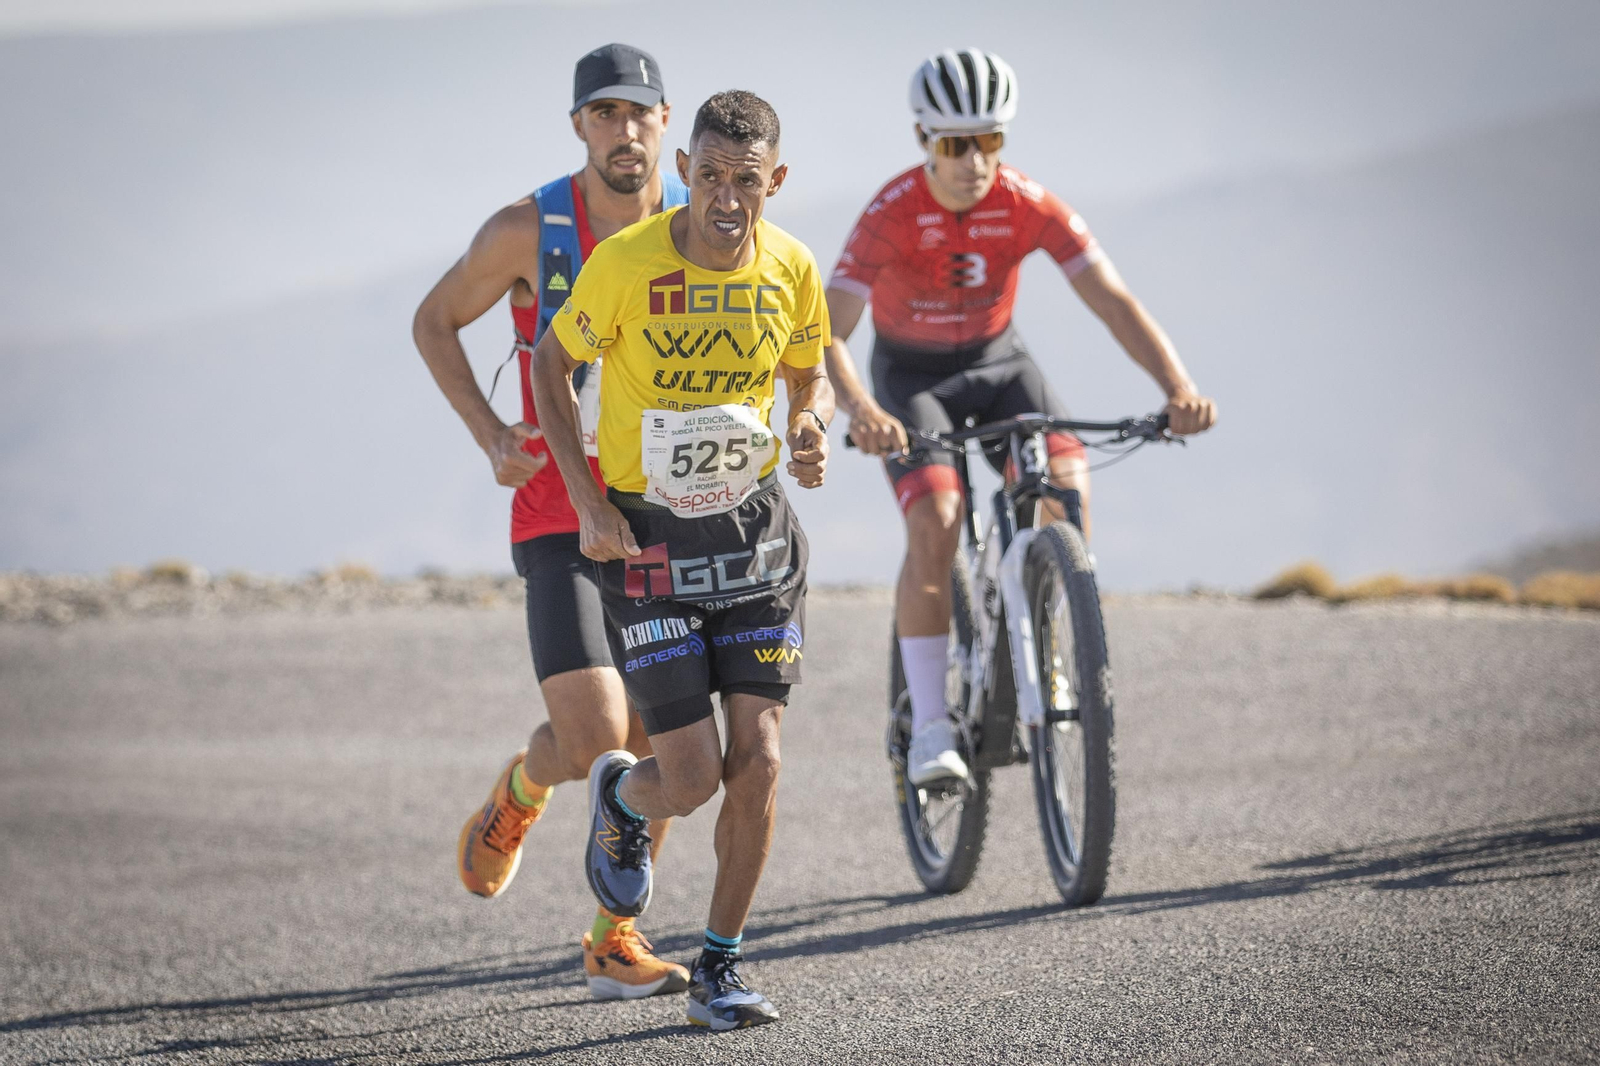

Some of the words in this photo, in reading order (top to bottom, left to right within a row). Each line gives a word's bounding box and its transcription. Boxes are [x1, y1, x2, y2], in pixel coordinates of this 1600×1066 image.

[649, 269, 780, 315] TGCC
[647, 321, 728, 330] CONSTRUISONS
[652, 369, 770, 394] ULTRA
[704, 424, 722, 432] PICO
[723, 422, 746, 431] VELETA
[671, 438, 748, 478] 525
[624, 537, 794, 598] TGCC
